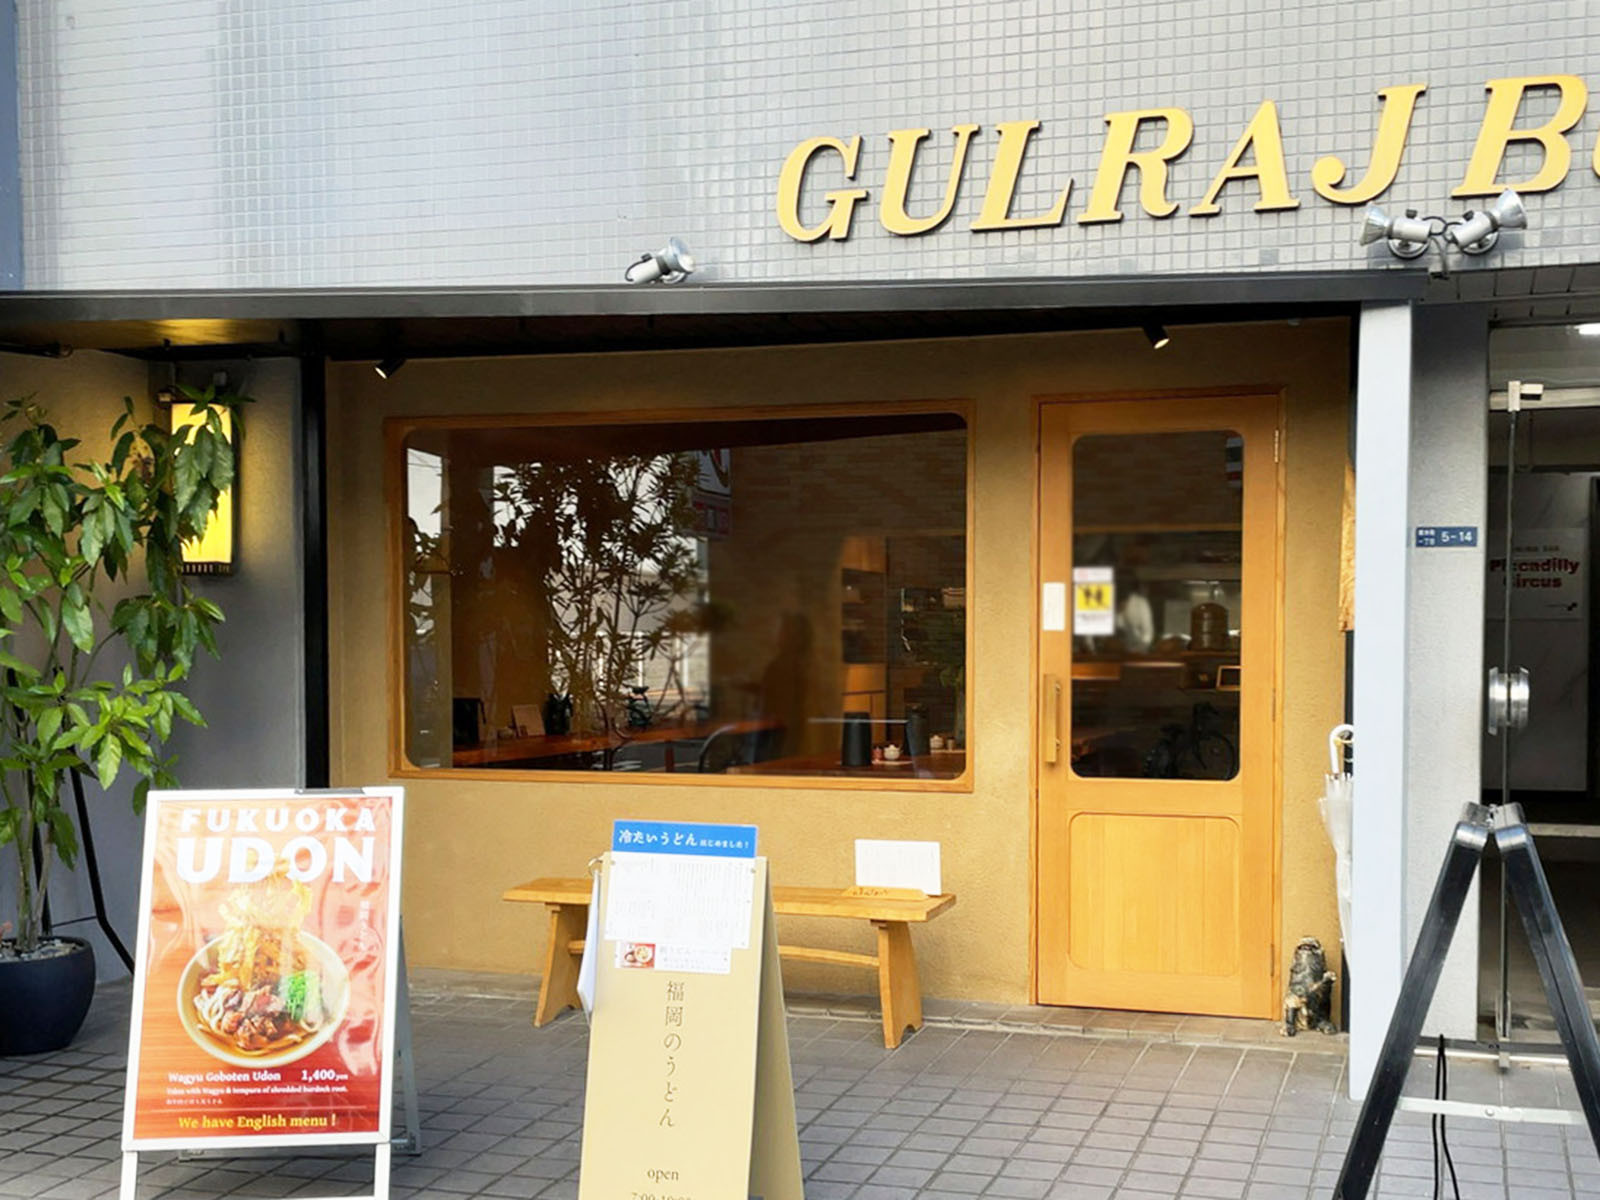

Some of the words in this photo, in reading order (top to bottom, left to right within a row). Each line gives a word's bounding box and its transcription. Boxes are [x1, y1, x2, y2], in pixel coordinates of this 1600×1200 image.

[775, 83, 1427, 243] GULRAJ
[1451, 73, 1600, 199] B
[1440, 531, 1473, 542] 5-14
[181, 807, 376, 833] FUKUOKA
[618, 829, 697, 846] 冷たいうどん
[175, 836, 376, 884] UDON
[659, 981, 685, 1128] 福岡のうどん
[168, 1071, 203, 1085] Wagyu
[205, 1070, 250, 1082] Goboten
[252, 1070, 281, 1082] Udon
[178, 1116, 199, 1128] We
[202, 1115, 234, 1128] have
[237, 1114, 286, 1131] English
[290, 1116, 328, 1128] menu
[647, 1169, 679, 1183] open
